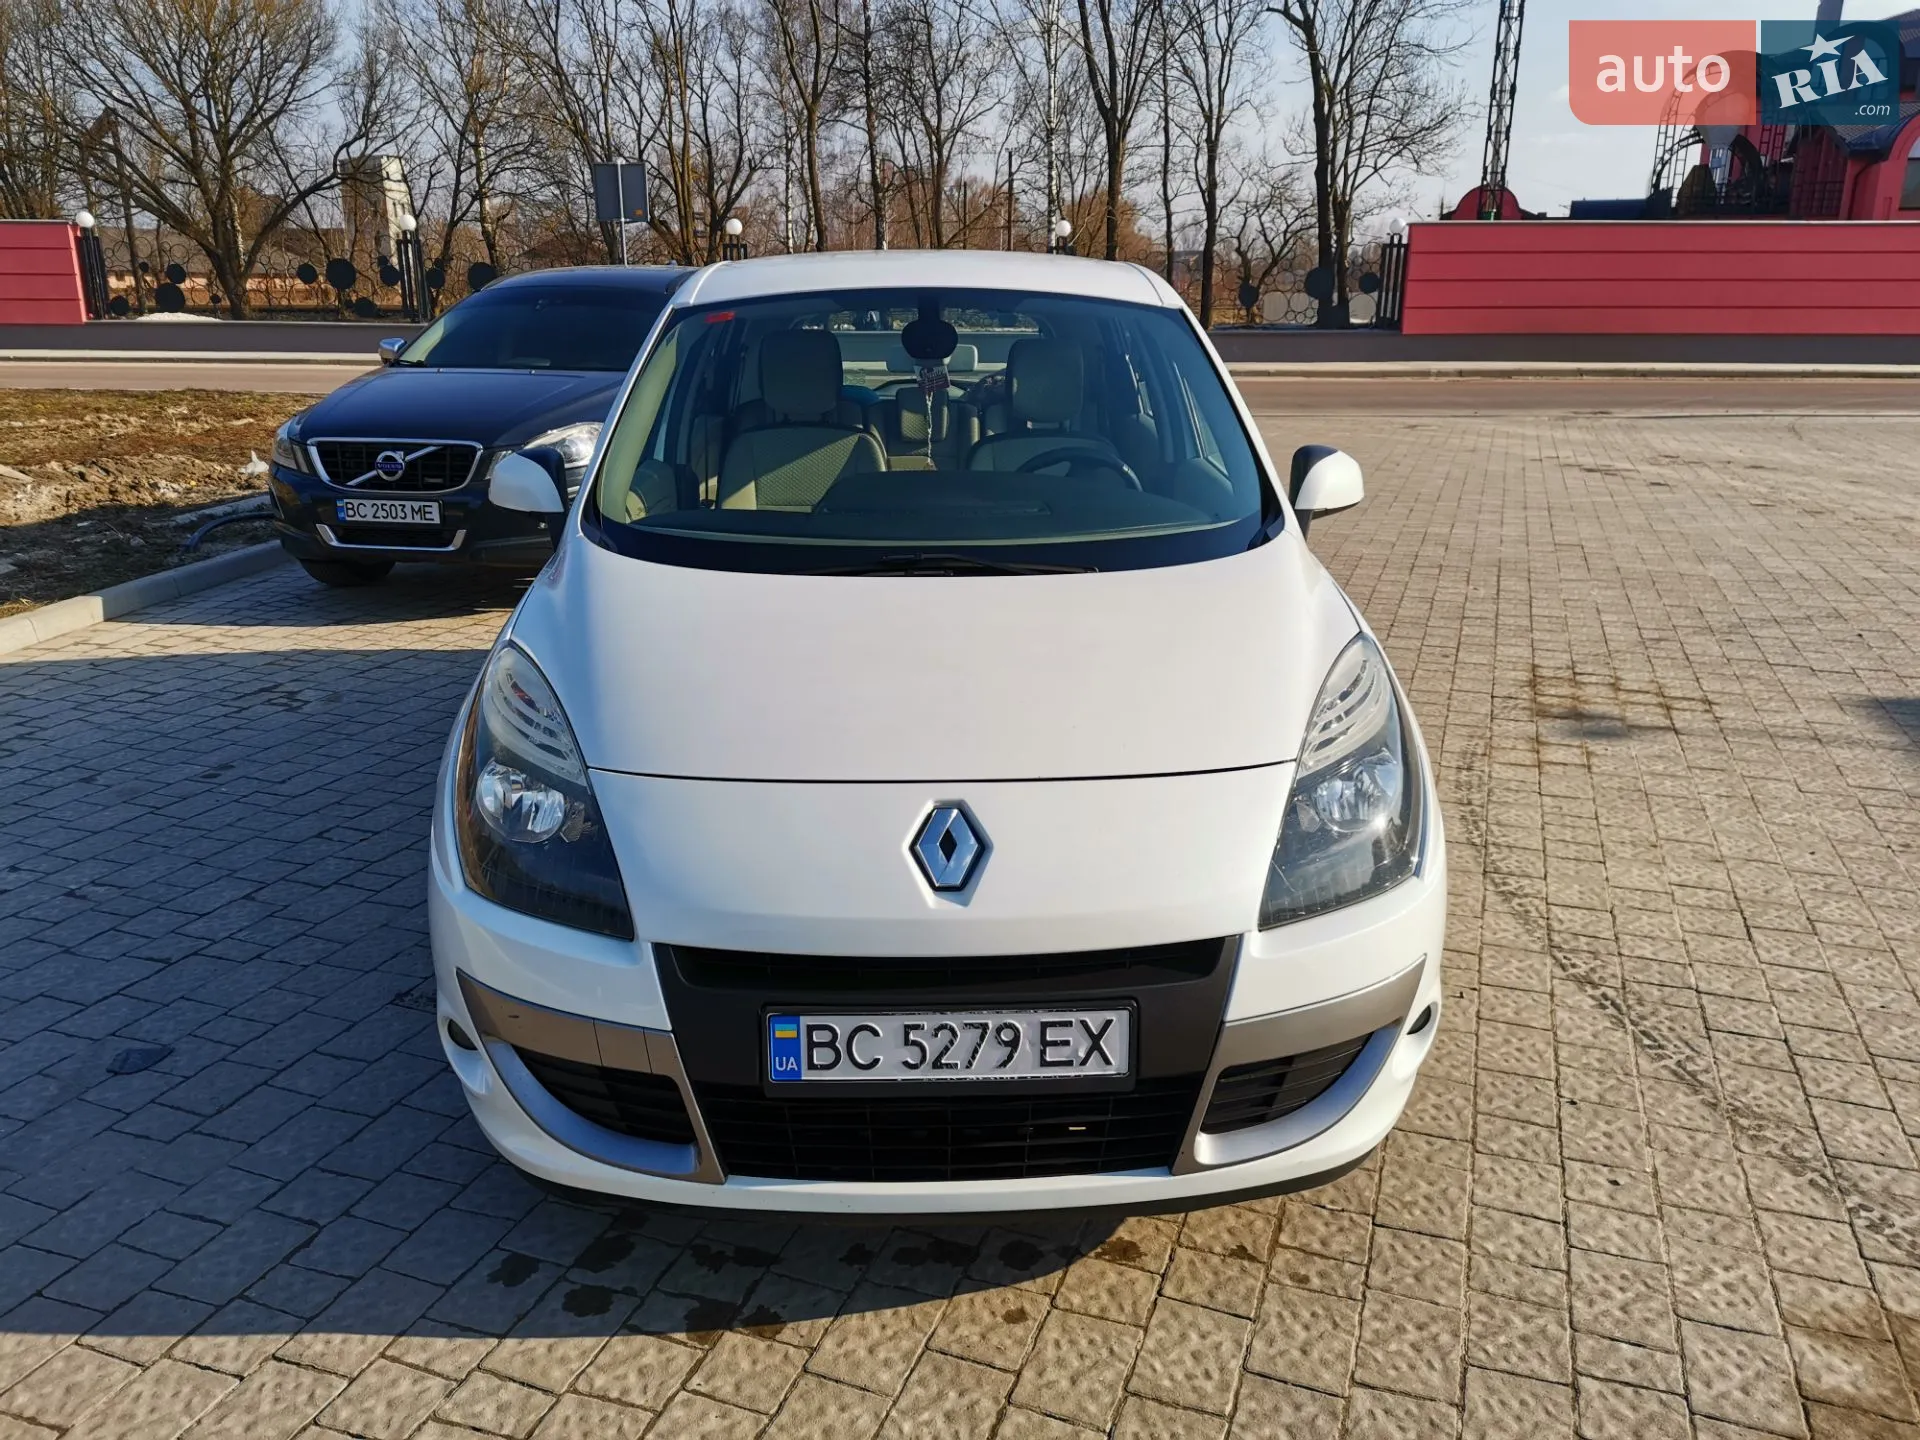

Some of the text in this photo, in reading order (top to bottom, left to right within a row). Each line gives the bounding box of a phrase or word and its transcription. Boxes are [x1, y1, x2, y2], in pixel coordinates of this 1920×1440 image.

[345, 501, 434, 521] BC 2503 ME
[806, 1018, 1116, 1071] BC 5279 EX
[775, 1056, 799, 1071] UA
